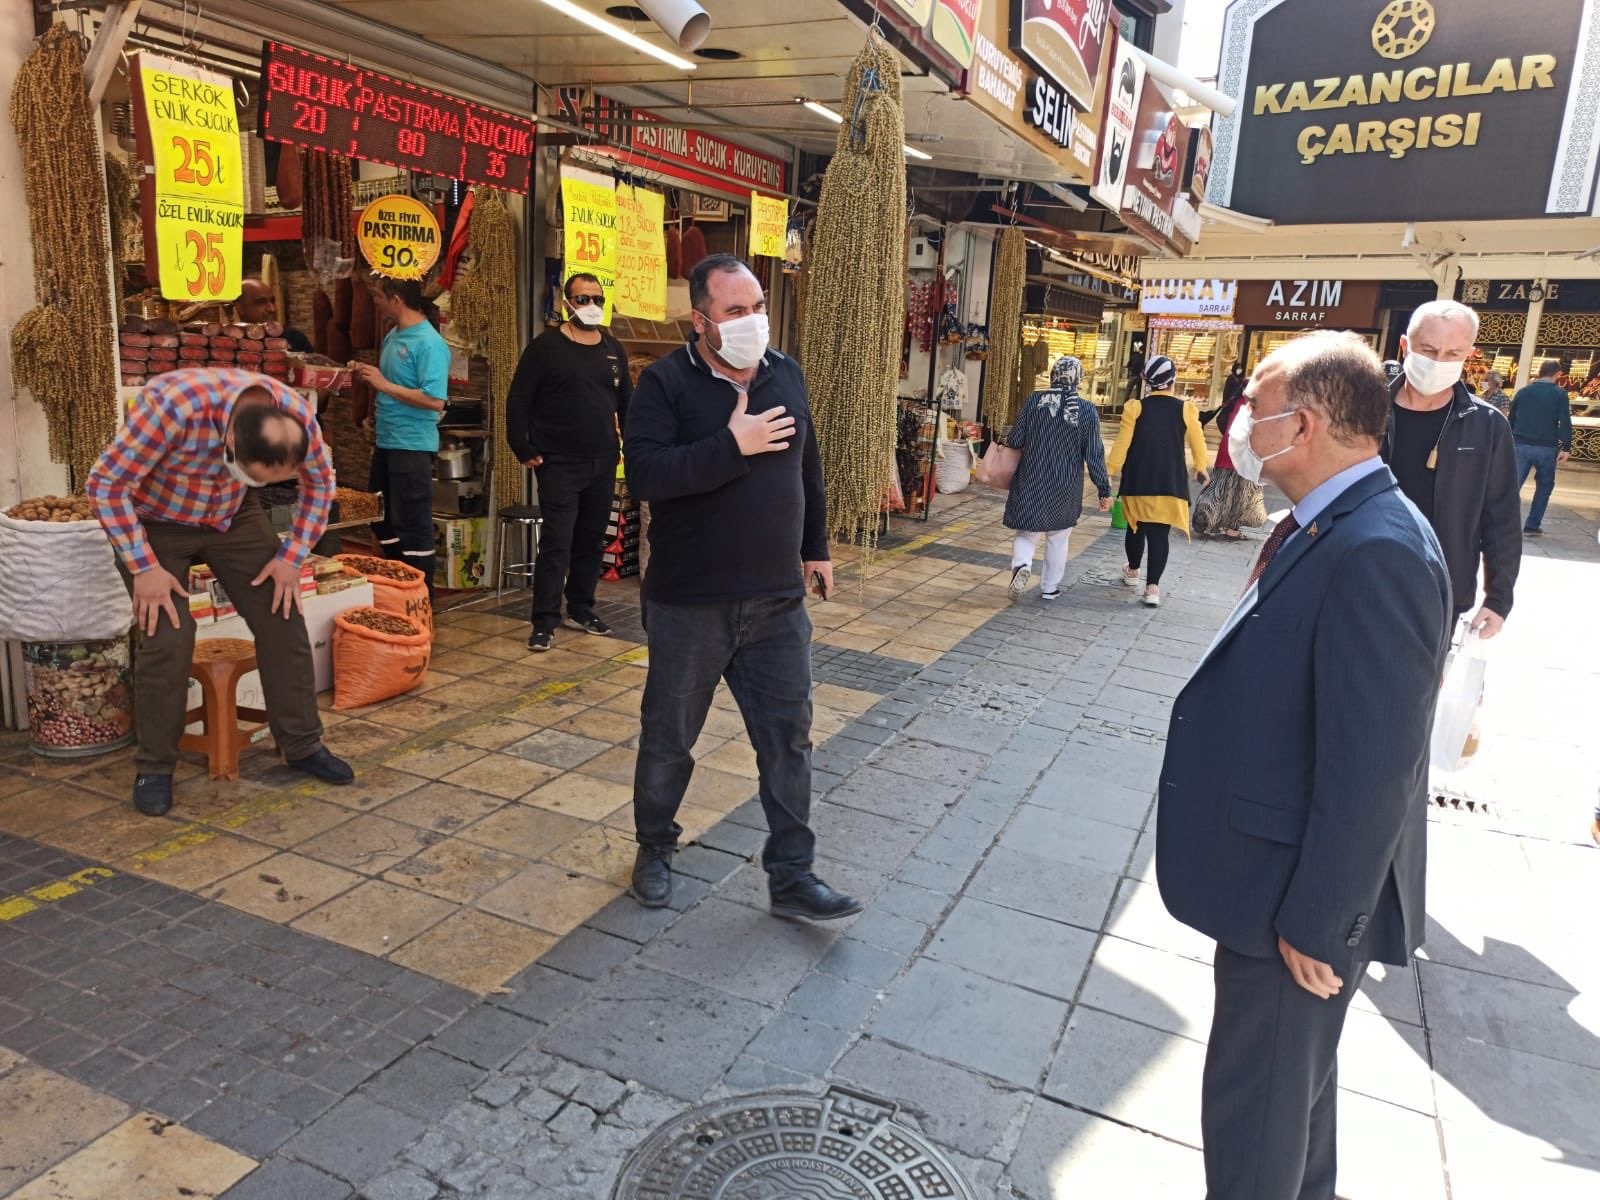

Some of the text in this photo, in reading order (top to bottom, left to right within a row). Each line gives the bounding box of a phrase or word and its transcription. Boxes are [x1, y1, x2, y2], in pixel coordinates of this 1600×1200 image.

[1253, 54, 1557, 115] KAZANCILAR
[195, 109, 238, 135] SUCUK
[269, 61, 352, 110] SUCUK
[360, 86, 460, 138] PASTIRMA
[468, 115, 530, 156] SUCUK
[293, 101, 327, 134] 20
[398, 128, 426, 157] 80
[1296, 112, 1482, 165] ÇARŞISI
[486, 150, 507, 178] 35
[695, 135, 727, 171] SUCUK
[159, 200, 185, 219] ÖZEL
[216, 210, 243, 229] SUCUK
[378, 209, 422, 225] ÖZEL FİYAT
[364, 221, 435, 244] PASTIRMA
[1143, 279, 1235, 300] MURAT
[1498, 283, 1560, 300] ZAE
[1199, 304, 1231, 313] SARRAF
[1275, 311, 1326, 321] SARRAF
